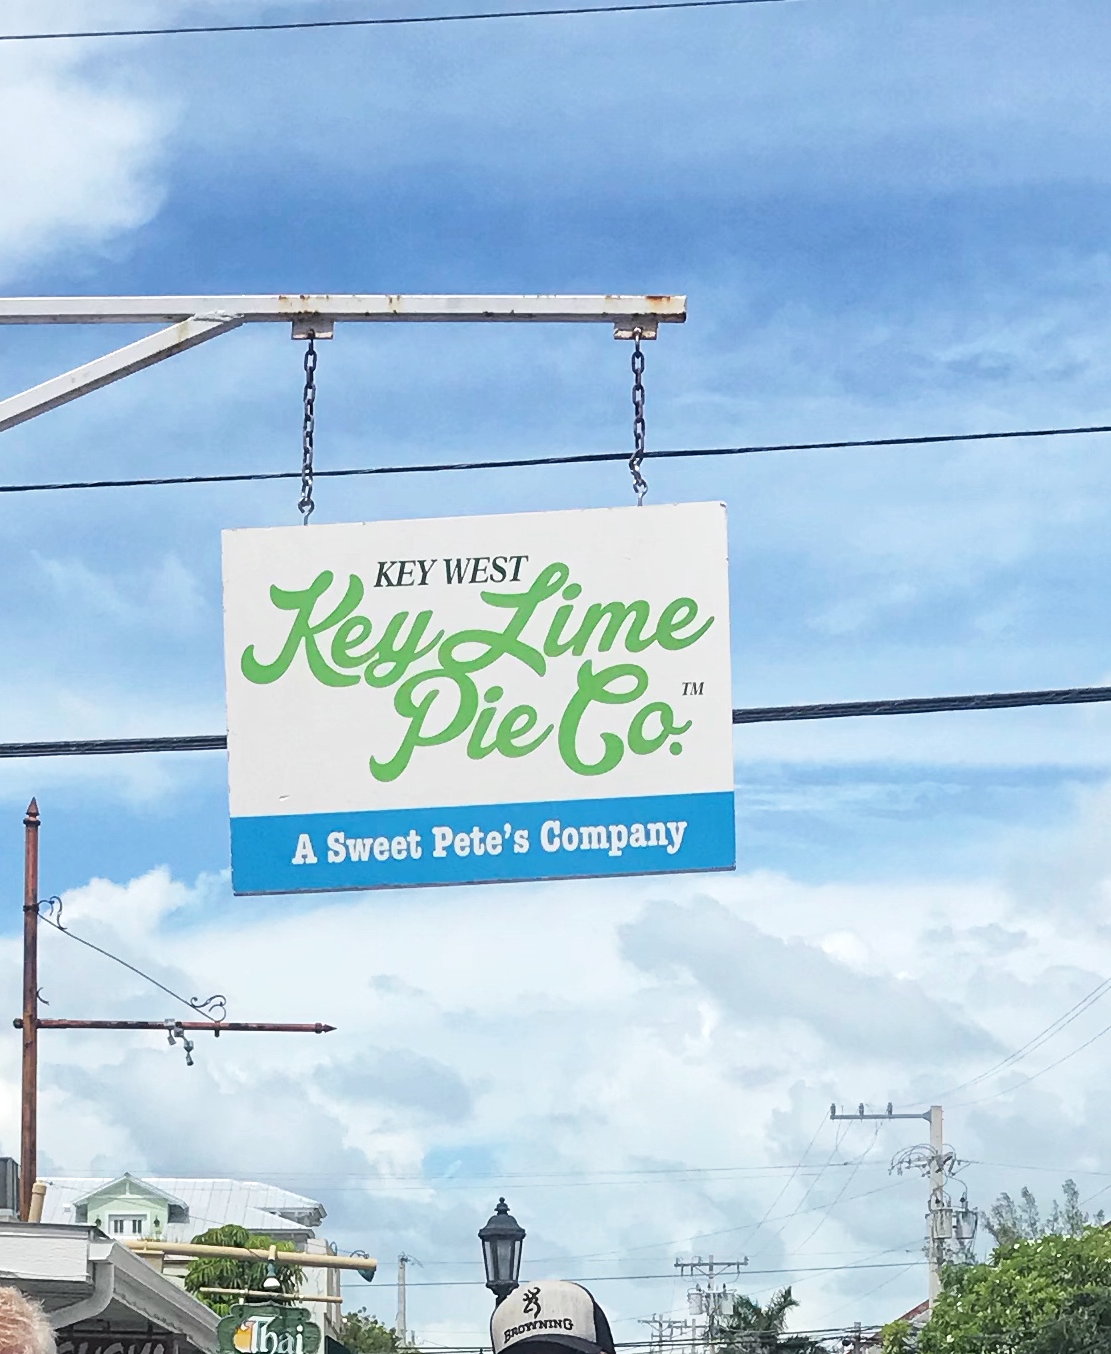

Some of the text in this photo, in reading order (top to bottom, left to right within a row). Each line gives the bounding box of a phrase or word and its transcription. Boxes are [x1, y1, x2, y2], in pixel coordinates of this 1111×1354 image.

[373, 555, 529, 588] KEY WEST
[241, 562, 714, 687] Key Lime
[369, 660, 693, 782] Pie Co.
[291, 820, 688, 865] A Sweet Pete's Company
[504, 1318, 574, 1344] BROWNING
